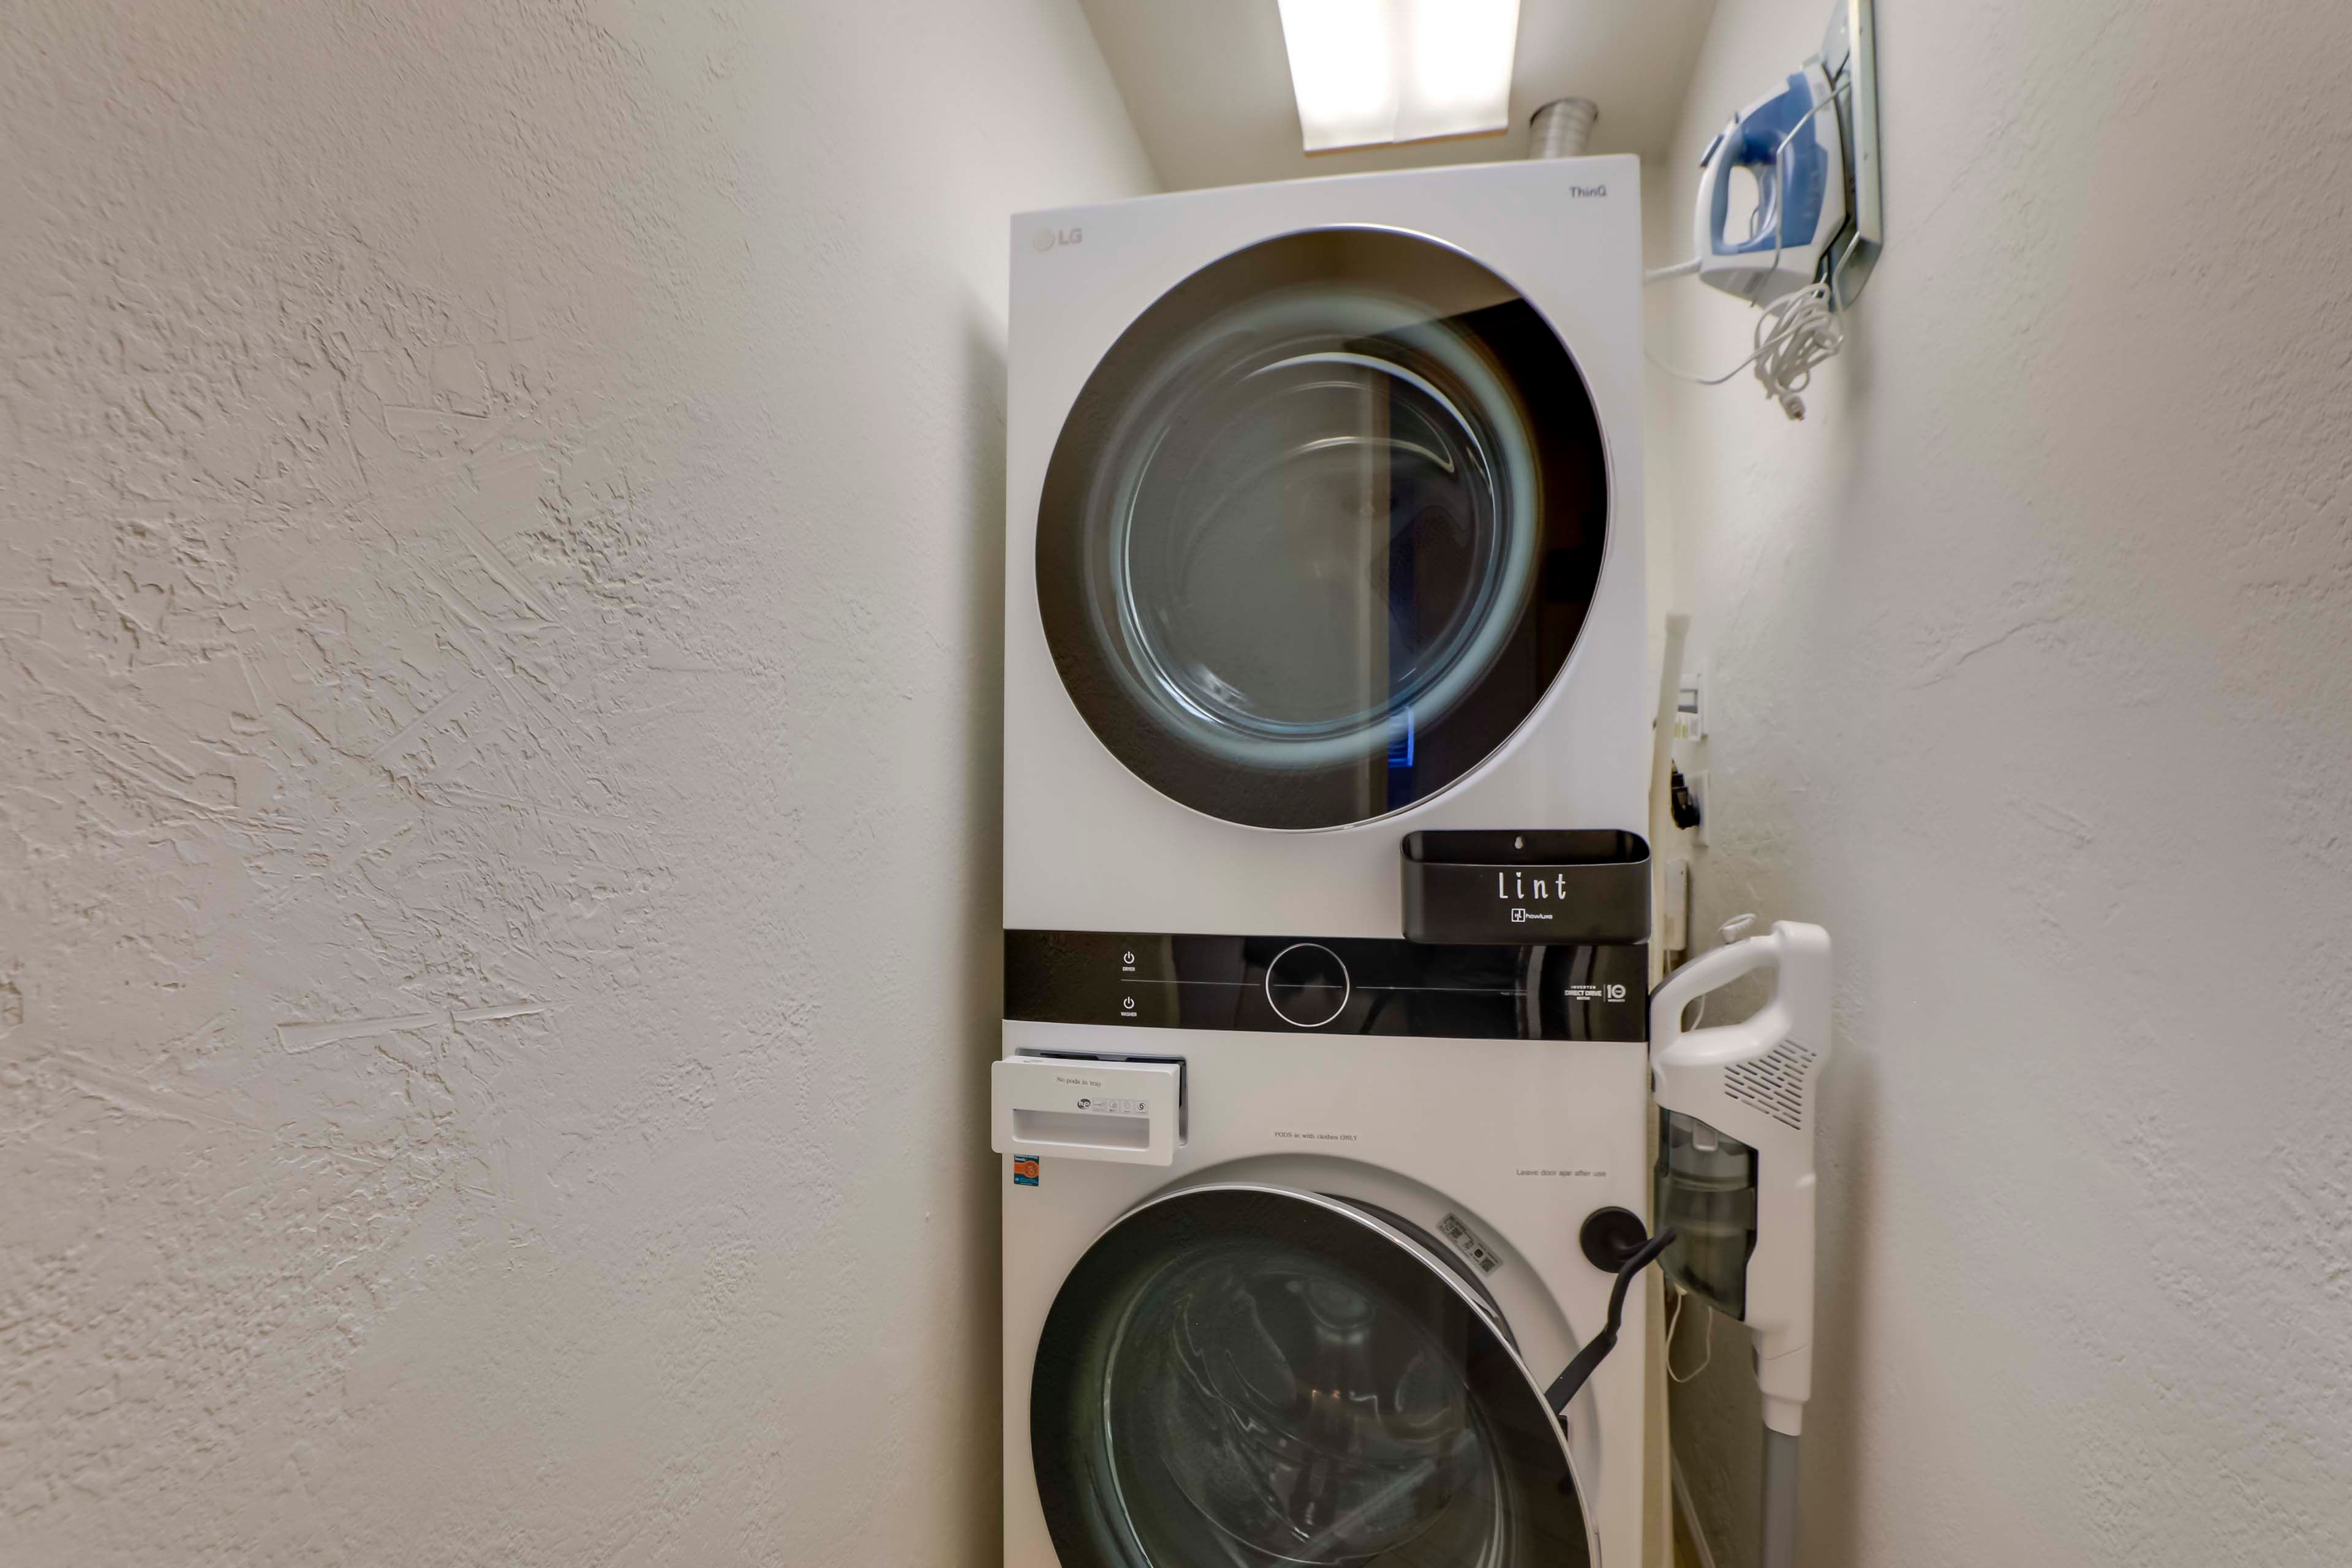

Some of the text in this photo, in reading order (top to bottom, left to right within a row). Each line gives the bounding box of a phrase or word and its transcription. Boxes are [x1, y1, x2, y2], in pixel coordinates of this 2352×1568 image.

[1569, 184, 1607, 198] ThinQ
[1058, 227, 1082, 246] LG
[1499, 872, 1566, 899] Lint
[1607, 984, 1626, 999] 10
